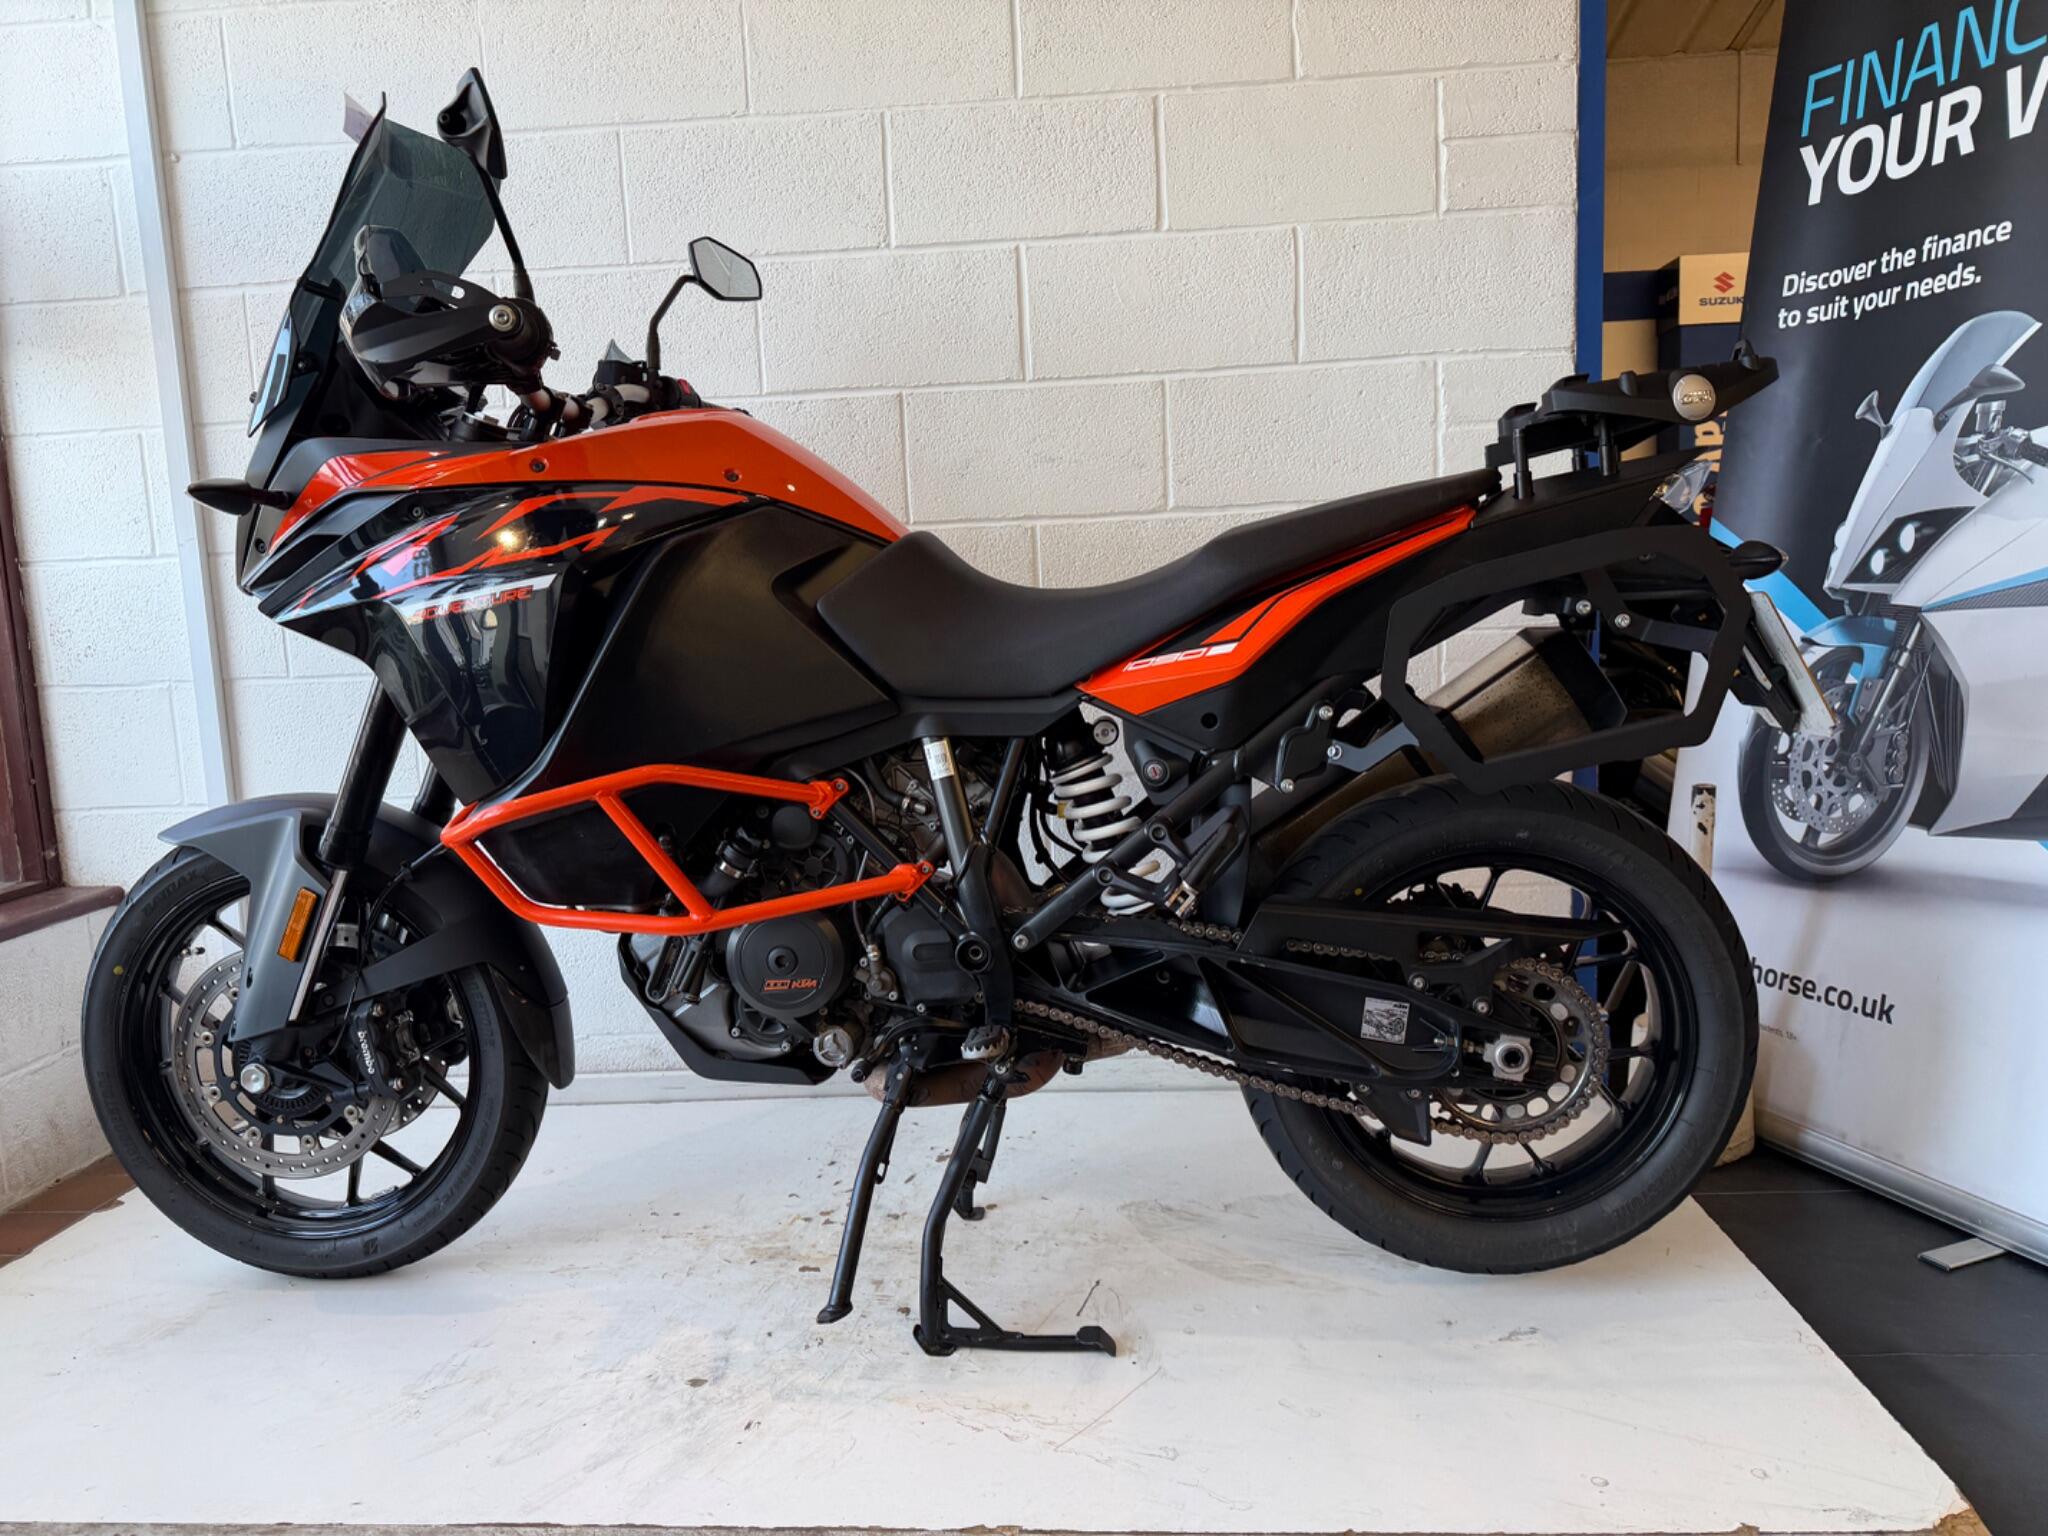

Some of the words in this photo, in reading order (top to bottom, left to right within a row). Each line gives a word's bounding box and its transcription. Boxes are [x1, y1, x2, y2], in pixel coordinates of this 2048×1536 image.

[1800, 84, 1983, 206] YOUR
[1781, 258, 1877, 298] Discover
[1880, 246, 1917, 275] the
[1921, 220, 2013, 263] finance
[1777, 308, 1801, 329] to
[1806, 295, 1849, 325] suit
[1852, 283, 1902, 320] your
[1904, 262, 1983, 301] needs.
[791, 978, 818, 989] KTM
[357, 1030, 375, 1075] brembo
